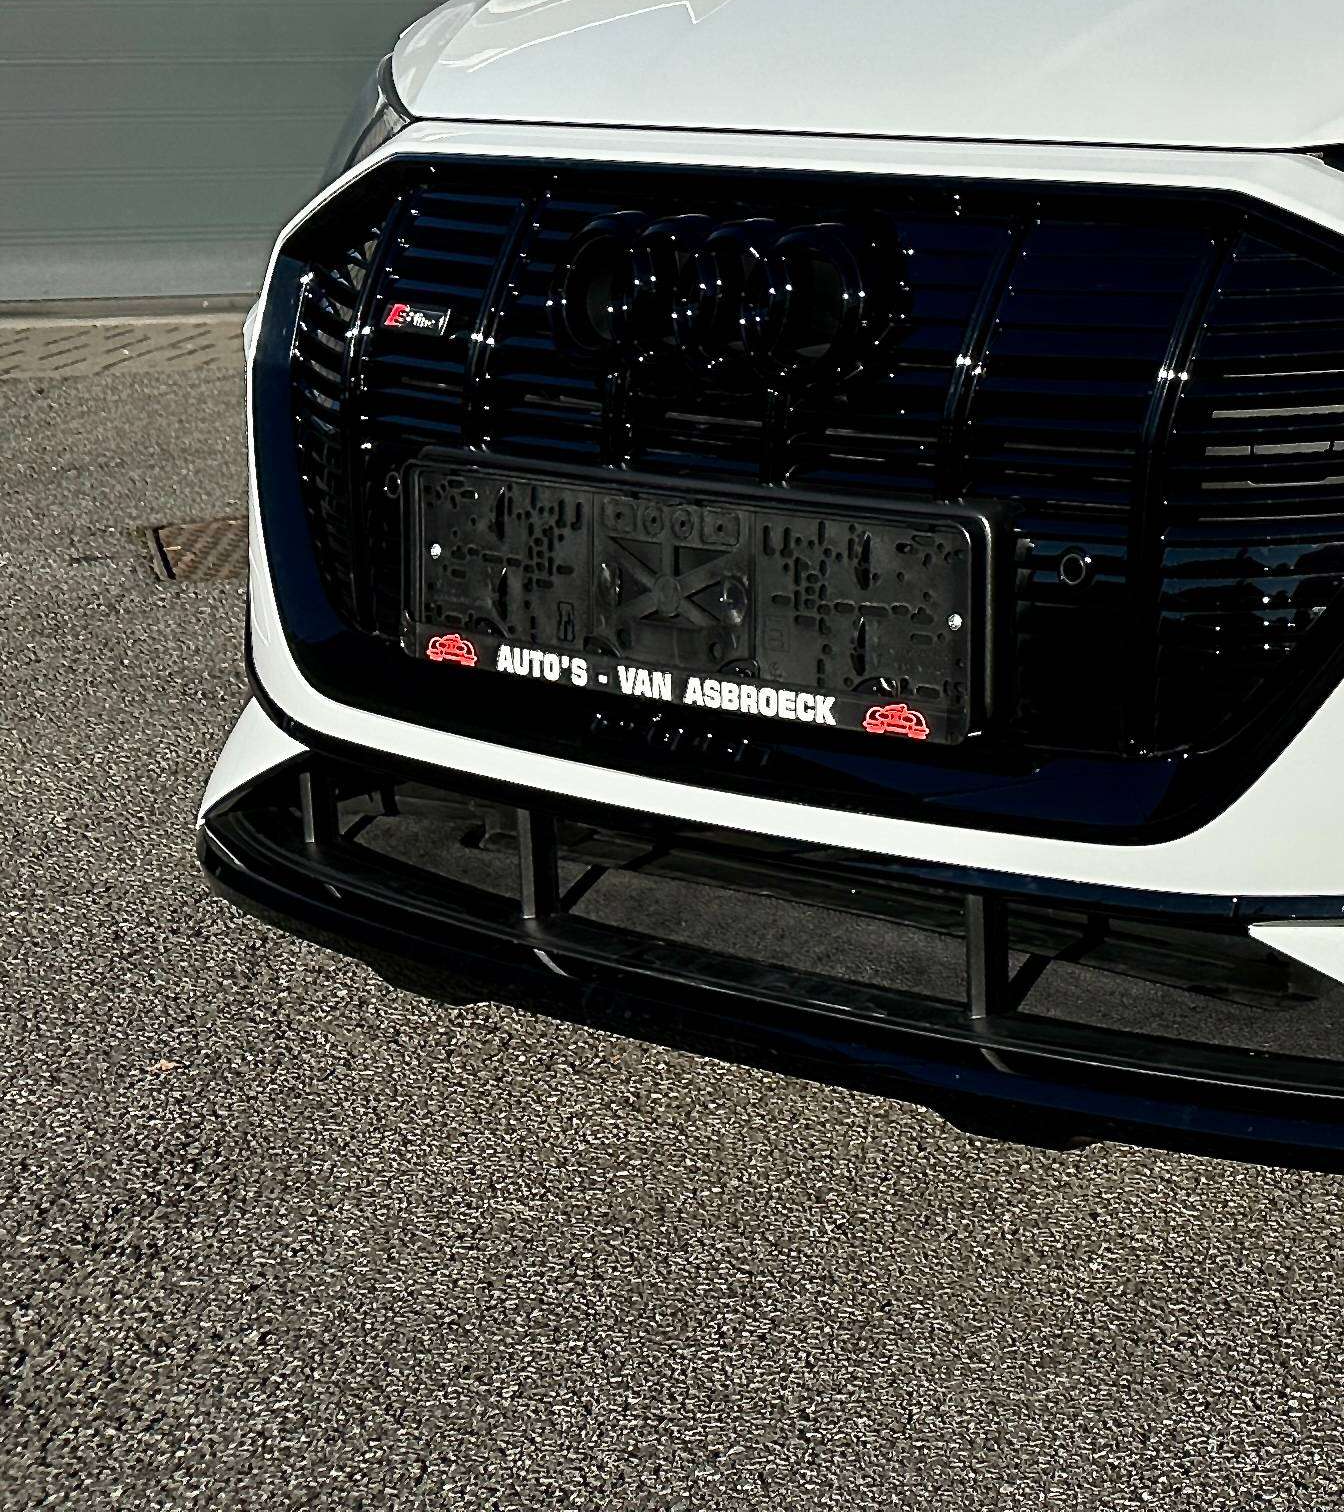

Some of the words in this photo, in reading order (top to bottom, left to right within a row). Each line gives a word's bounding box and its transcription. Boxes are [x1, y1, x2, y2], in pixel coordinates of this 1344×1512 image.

[497, 645, 588, 687] AUTO'S
[618, 666, 672, 702] VAN
[683, 676, 836, 726] ASBROECK
